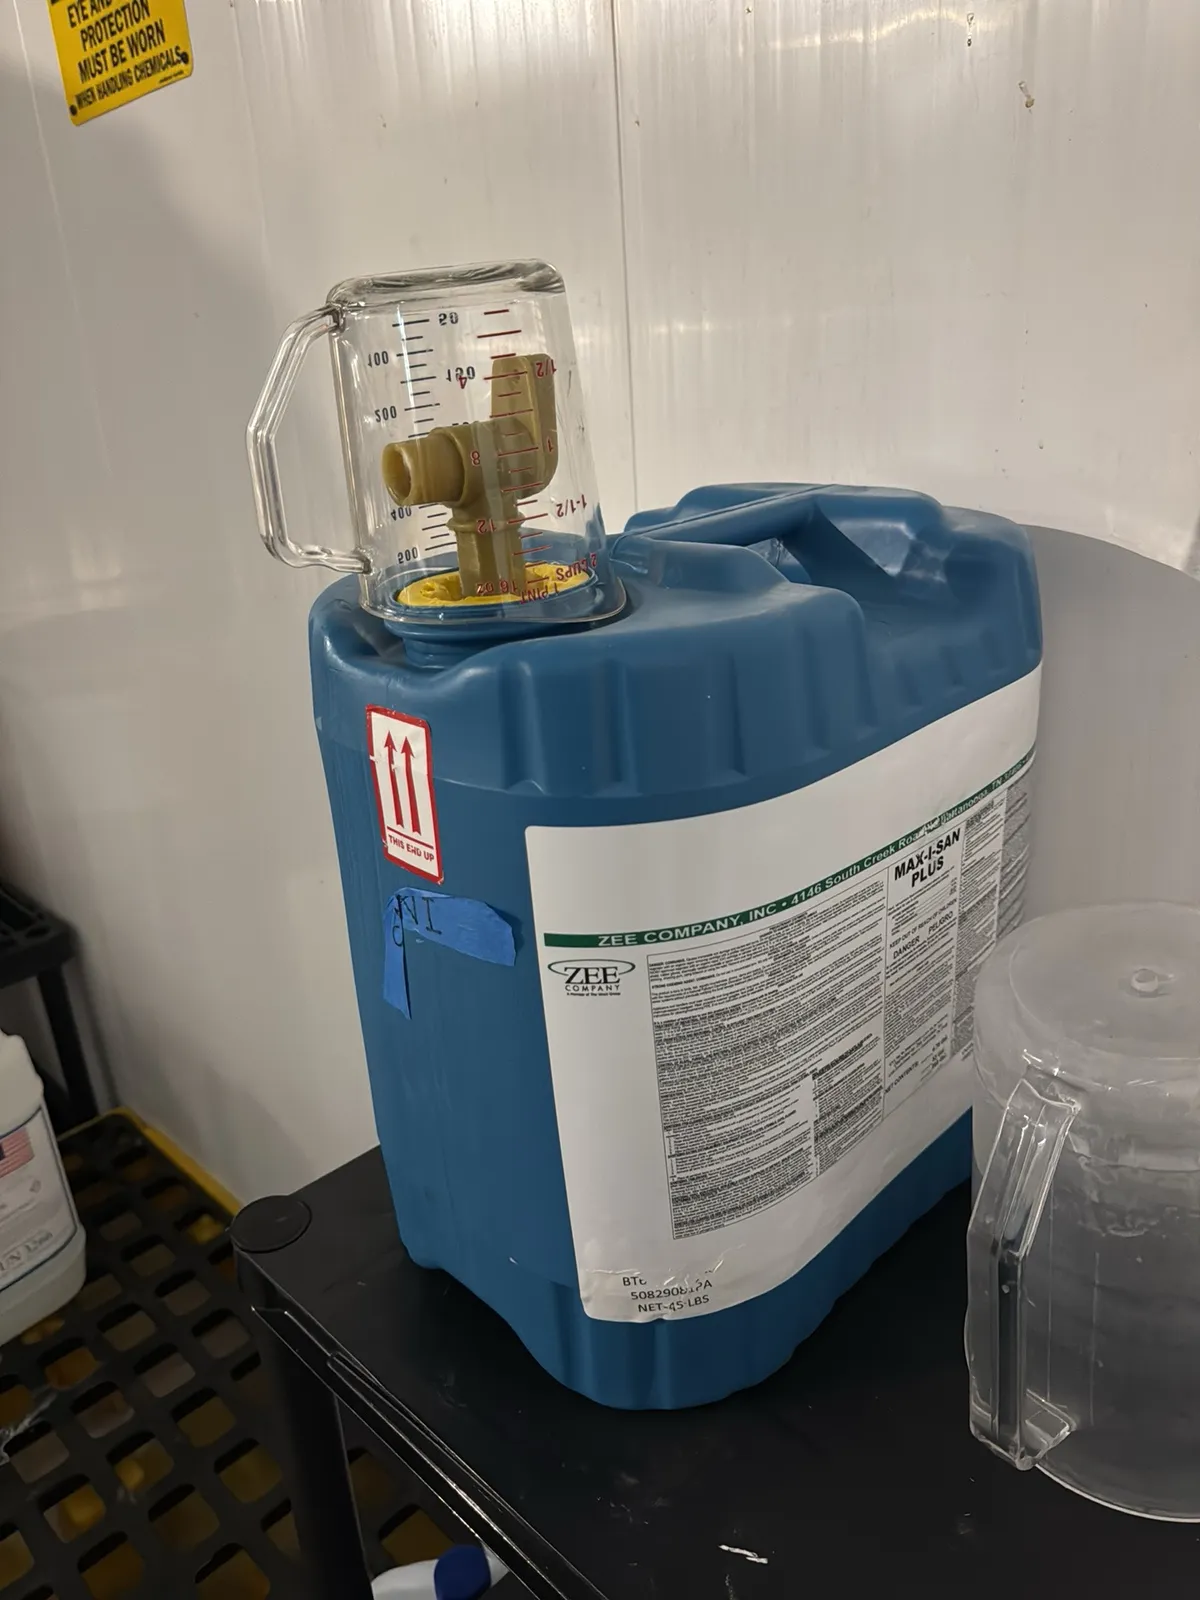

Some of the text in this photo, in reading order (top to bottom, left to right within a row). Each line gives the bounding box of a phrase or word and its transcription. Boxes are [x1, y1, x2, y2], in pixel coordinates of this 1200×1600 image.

[67, 0, 89, 28] EYE
[80, 0, 151, 52] PROTECTION
[78, 18, 166, 84] MUST BE WORN
[95, 68, 134, 100] HANDLING
[133, 45, 182, 83] CHEMICALS
[535, 359, 557, 378] 1/2
[555, 494, 588, 518] 1-1/2
[388, 834, 435, 861] THIS END UP
[895, 828, 961, 880] MAX-I-SAN
[911, 856, 944, 888] PLUS
[598, 933, 638, 947] ZEE
[644, 915, 745, 943] COMPANY,
[749, 903, 777, 921] INC
[791, 883, 822, 905] 4146
[825, 864, 861, 889] South
[863, 844, 896, 868] Creek
[928, 910, 954, 934] PELIGRO
[893, 935, 920, 959] DANGER
[564, 966, 621, 984] ZEE
[565, 984, 620, 992] COMPANY
